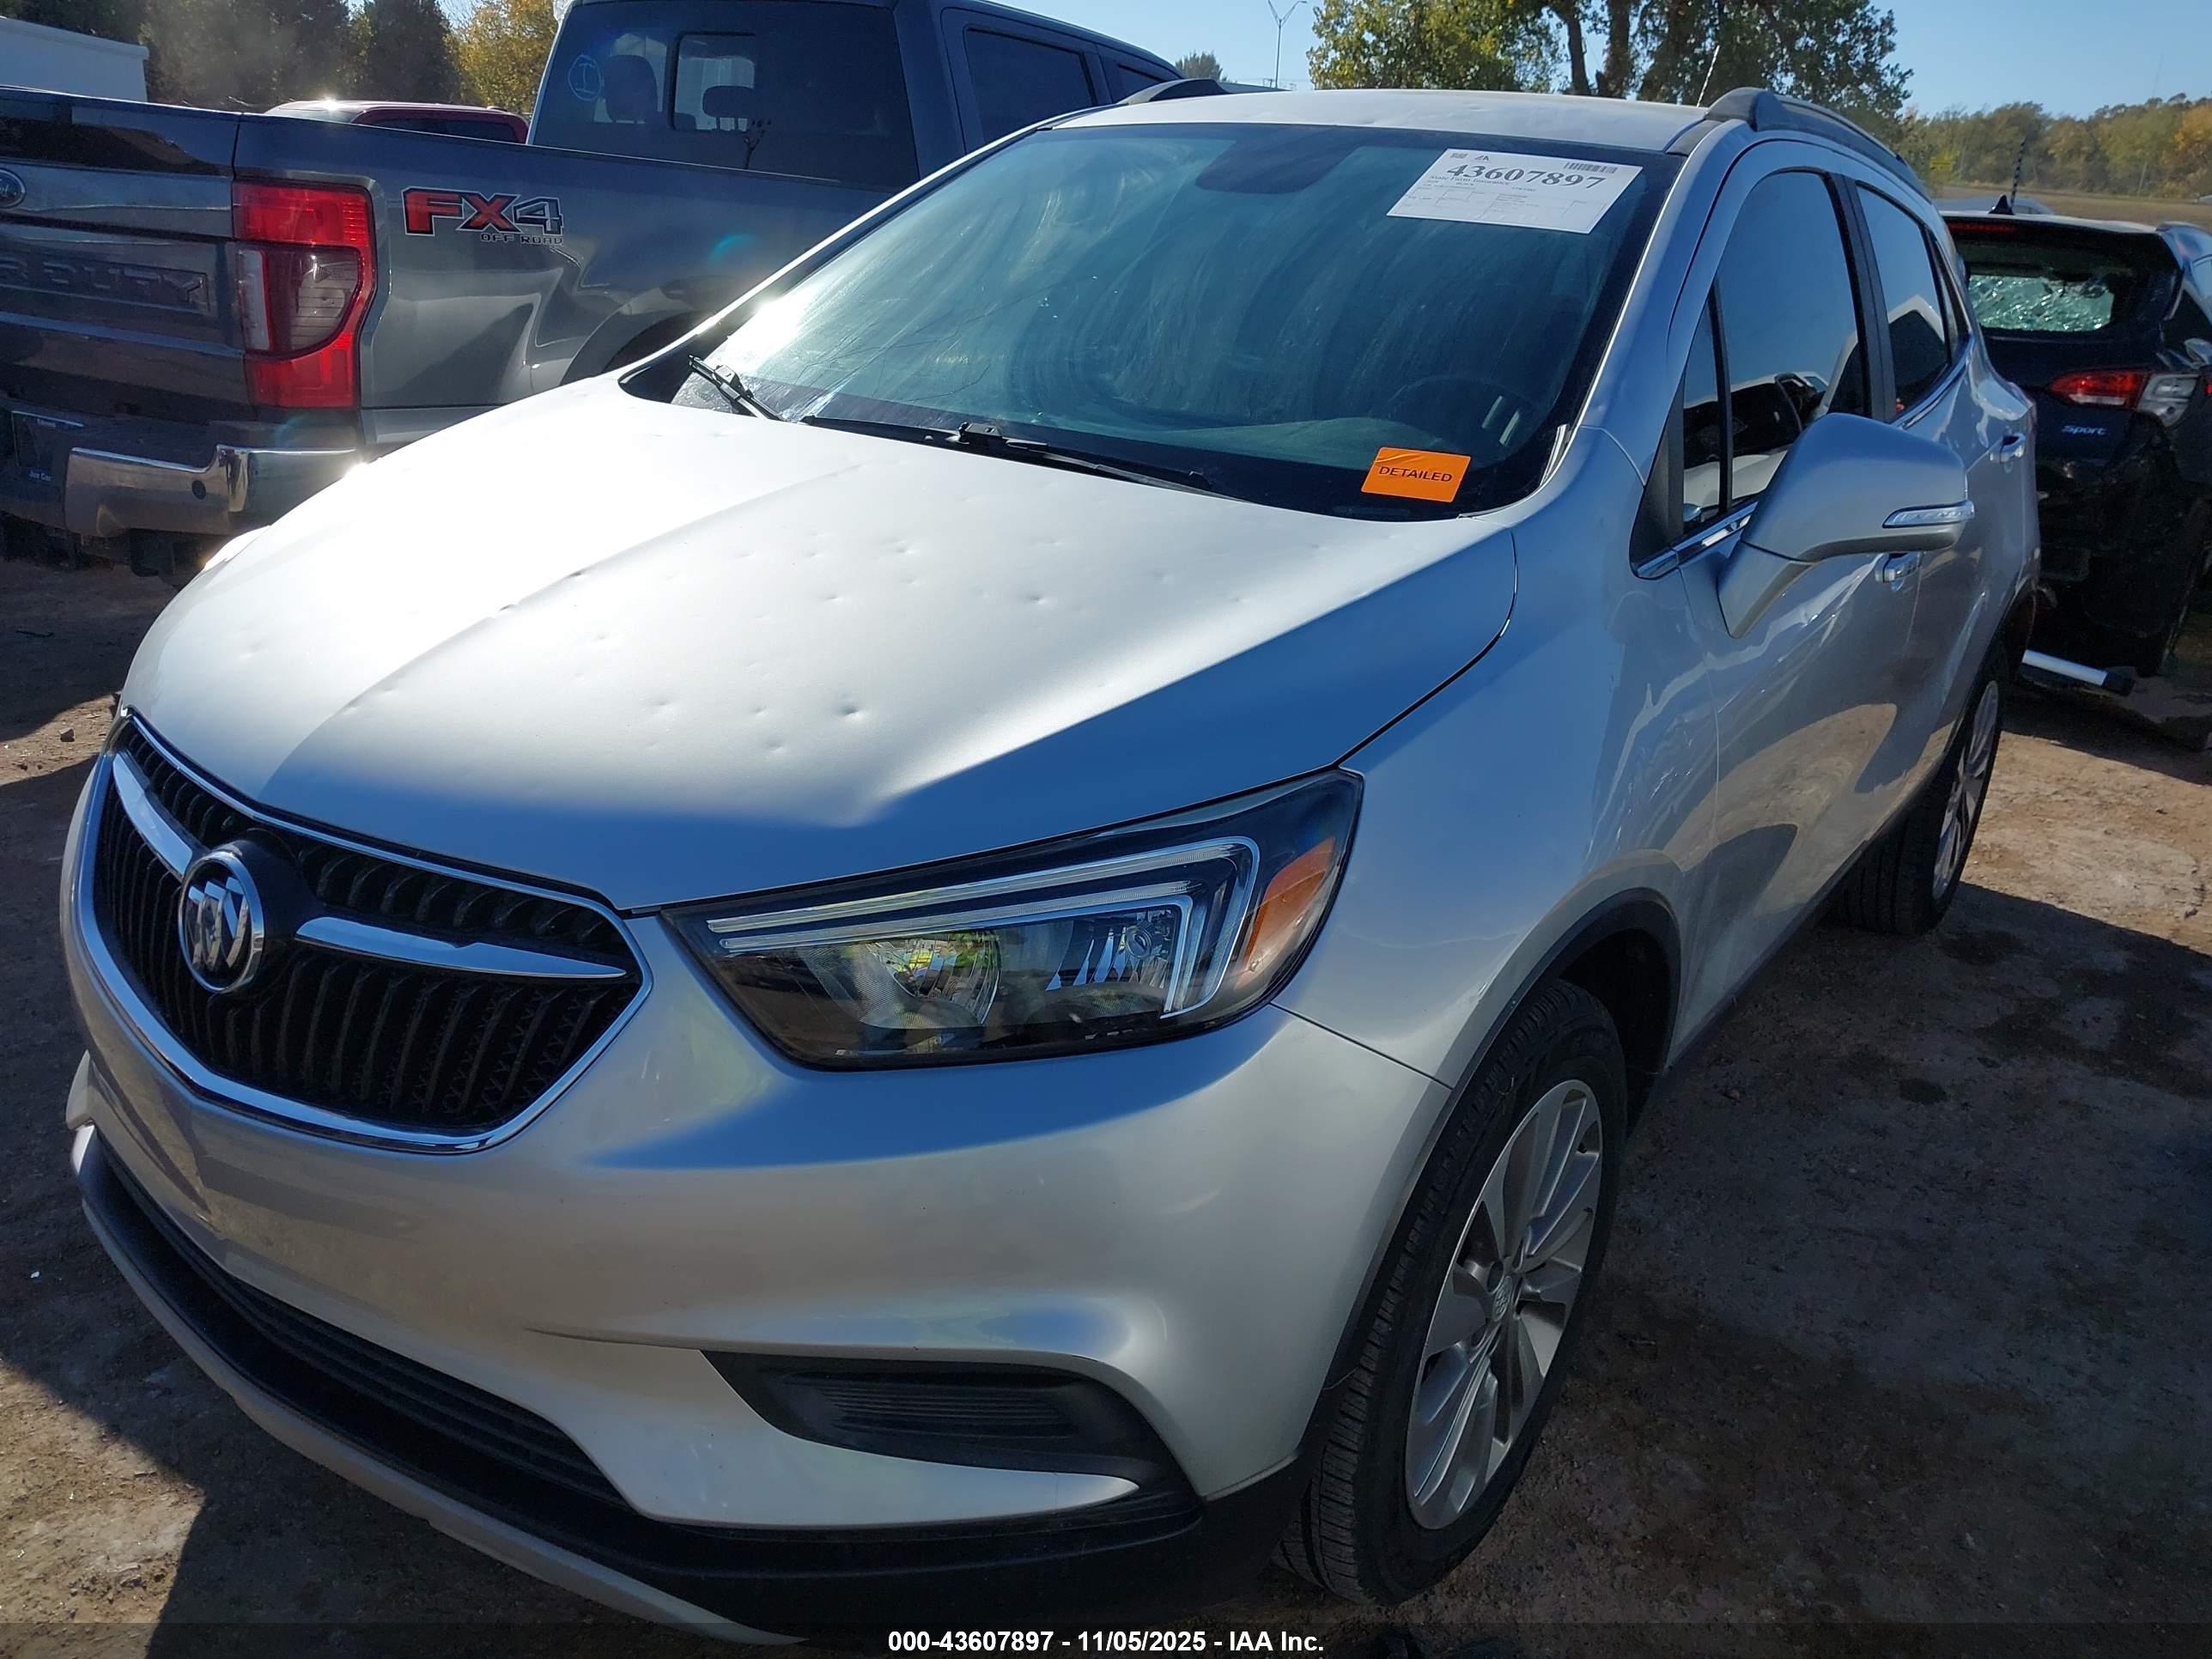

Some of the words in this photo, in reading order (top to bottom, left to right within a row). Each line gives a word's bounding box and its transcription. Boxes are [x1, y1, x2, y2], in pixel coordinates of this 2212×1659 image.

[1447, 164, 1606, 189] 43607897
[401, 185, 564, 236] FX4
[480, 233, 515, 243] OFF
[520, 234, 563, 246] ROAD
[42, 259, 204, 303] DUTY
[1378, 466, 1453, 483] DETAILED
